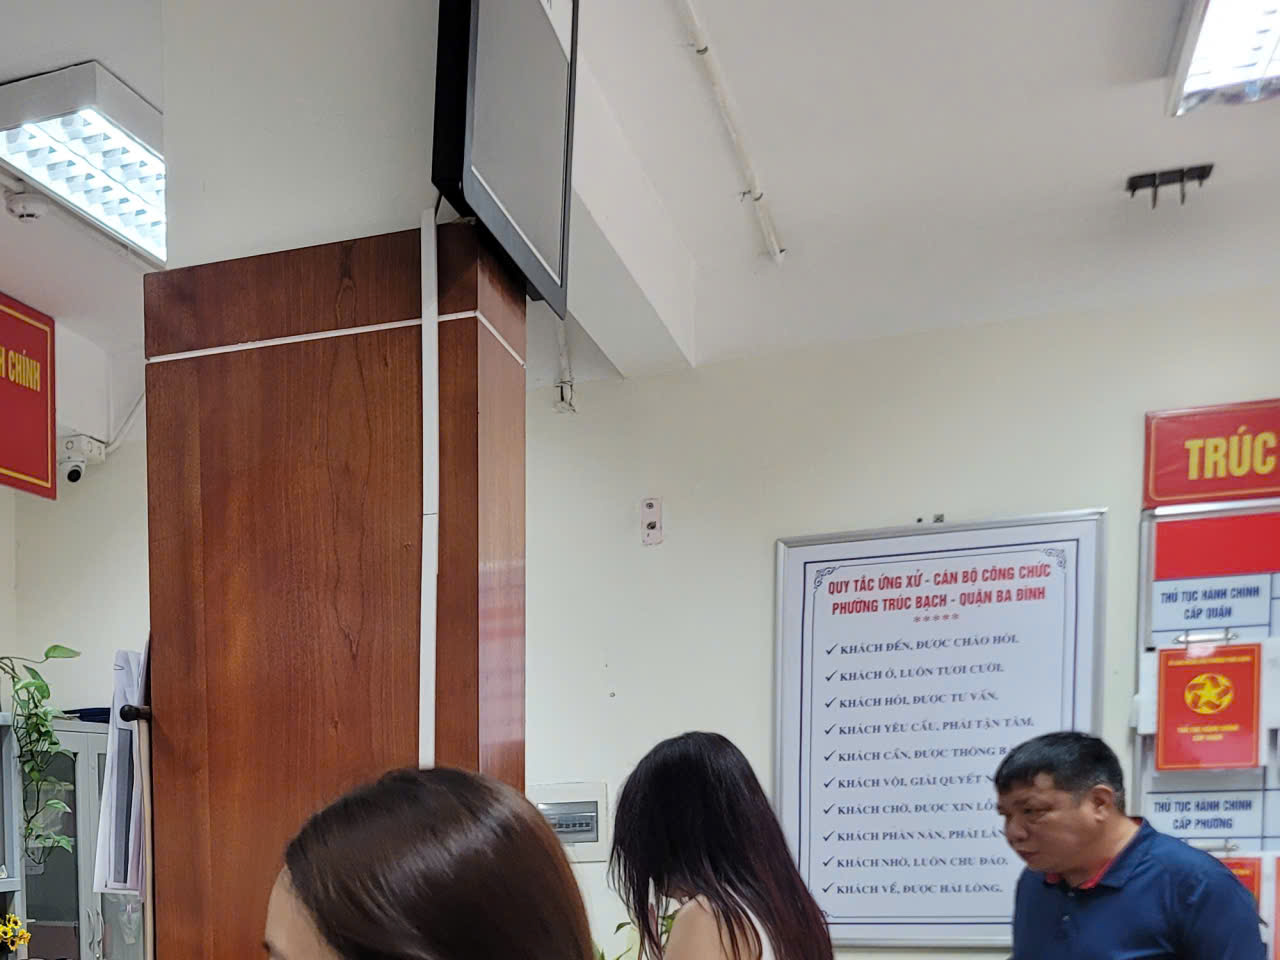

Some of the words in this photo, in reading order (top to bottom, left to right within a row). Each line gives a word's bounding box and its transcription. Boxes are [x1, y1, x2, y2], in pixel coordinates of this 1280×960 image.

[7, 349, 40, 392] CHÍNH
[1184, 425, 1278, 481] TRÚC
[828, 580, 850, 595] QUY
[878, 573, 902, 591] ỨNG
[906, 569, 924, 588] XỬ
[933, 568, 959, 586] CÁN
[962, 567, 978, 587] BỘ
[981, 564, 1015, 582] CÔNG
[1018, 560, 1052, 579] CHỨC
[832, 597, 879, 616] PHƯỜNG
[882, 594, 912, 612] TRÚC
[915, 594, 947, 612] BẠCH
[959, 589, 993, 610] QUẬN
[996, 588, 1012, 603] BA
[1016, 585, 1046, 601] ĐÌNH
[840, 642, 883, 656] KHÁCH
[839, 668, 882, 682] KHÁCH
[839, 696, 882, 709] KHÁCH
[838, 723, 881, 736] KHÁCH
[838, 750, 880, 763] KHÁCH
[837, 776, 880, 789] KHÁCH
[837, 802, 880, 816] KHÁCH
[952, 801, 974, 813] XIN
[837, 830, 879, 842] KHÁCH
[836, 856, 879, 868] KHÁCH
[836, 882, 879, 895] KHÁCH
